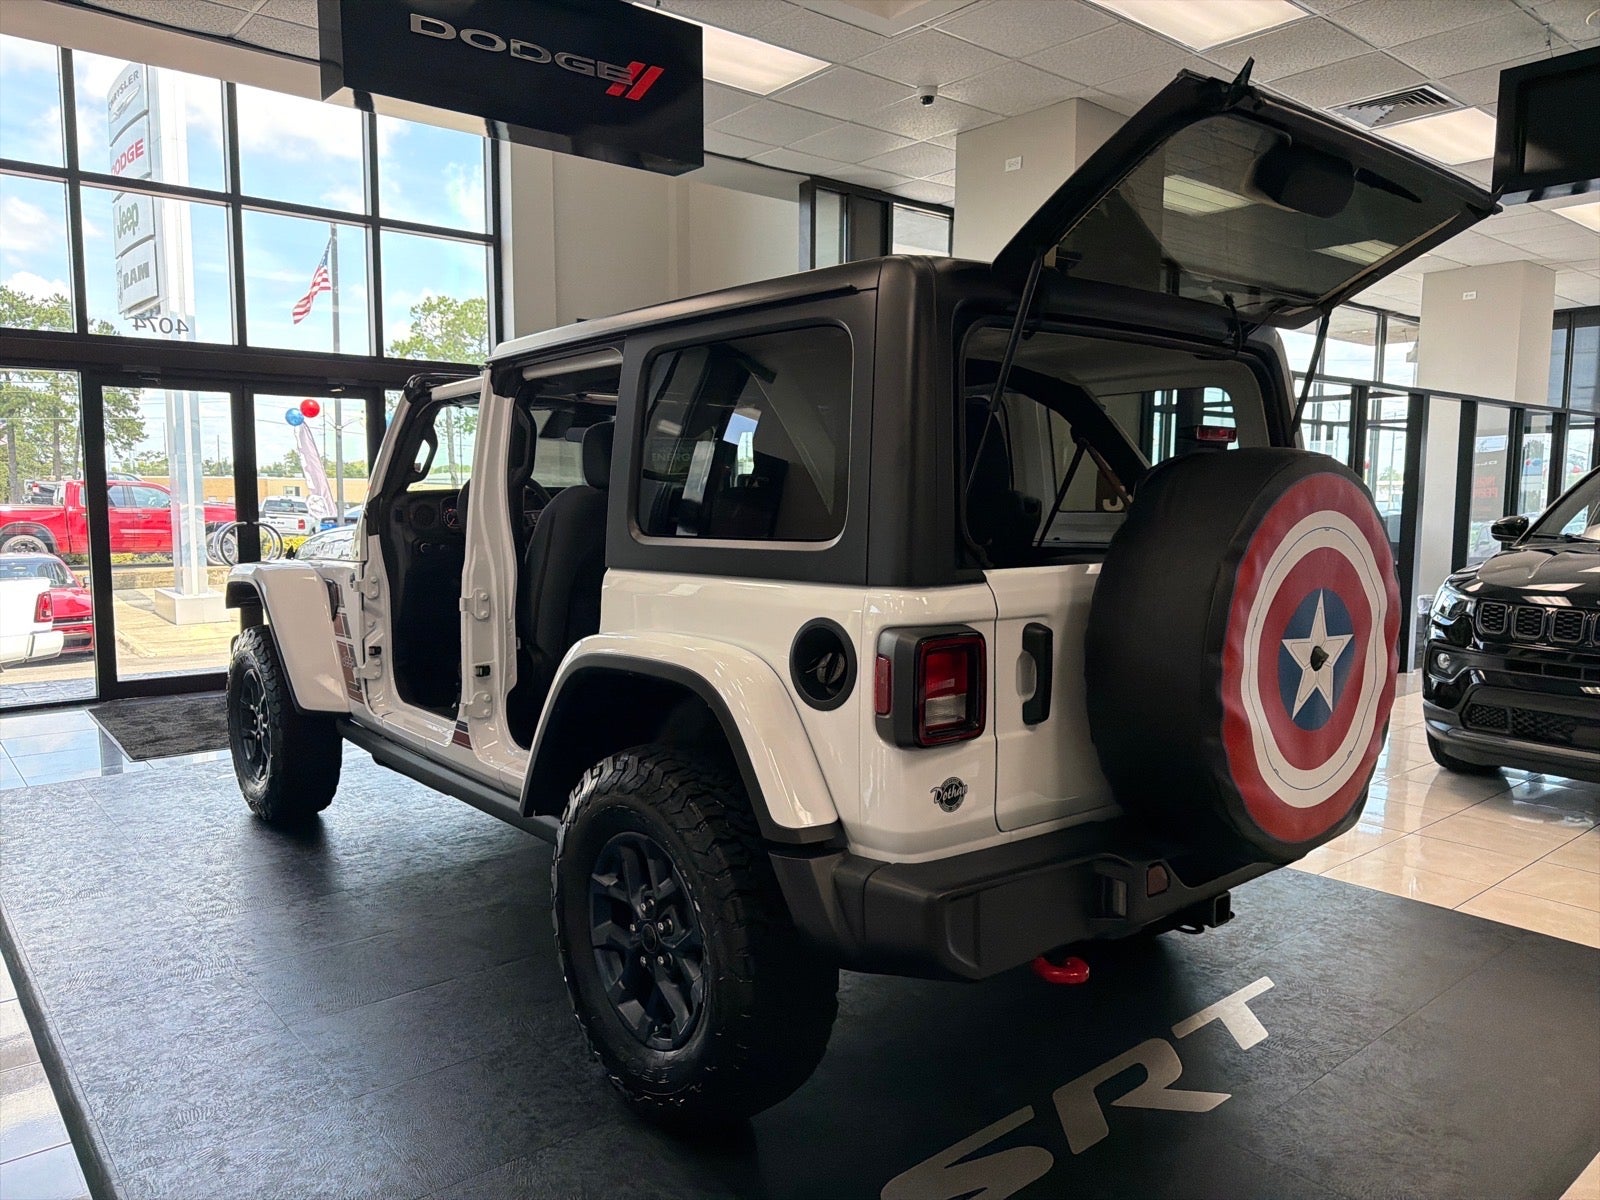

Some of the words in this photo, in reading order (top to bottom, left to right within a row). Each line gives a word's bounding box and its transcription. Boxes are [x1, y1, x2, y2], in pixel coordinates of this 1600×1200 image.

[410, 13, 633, 85] DODGE
[108, 70, 139, 111] CHRYSLER
[111, 138, 145, 175] DODGE
[117, 202, 139, 239] Jeep
[123, 262, 149, 290] RAM
[930, 784, 968, 804] Dothan
[880, 976, 1275, 1200] SRT
